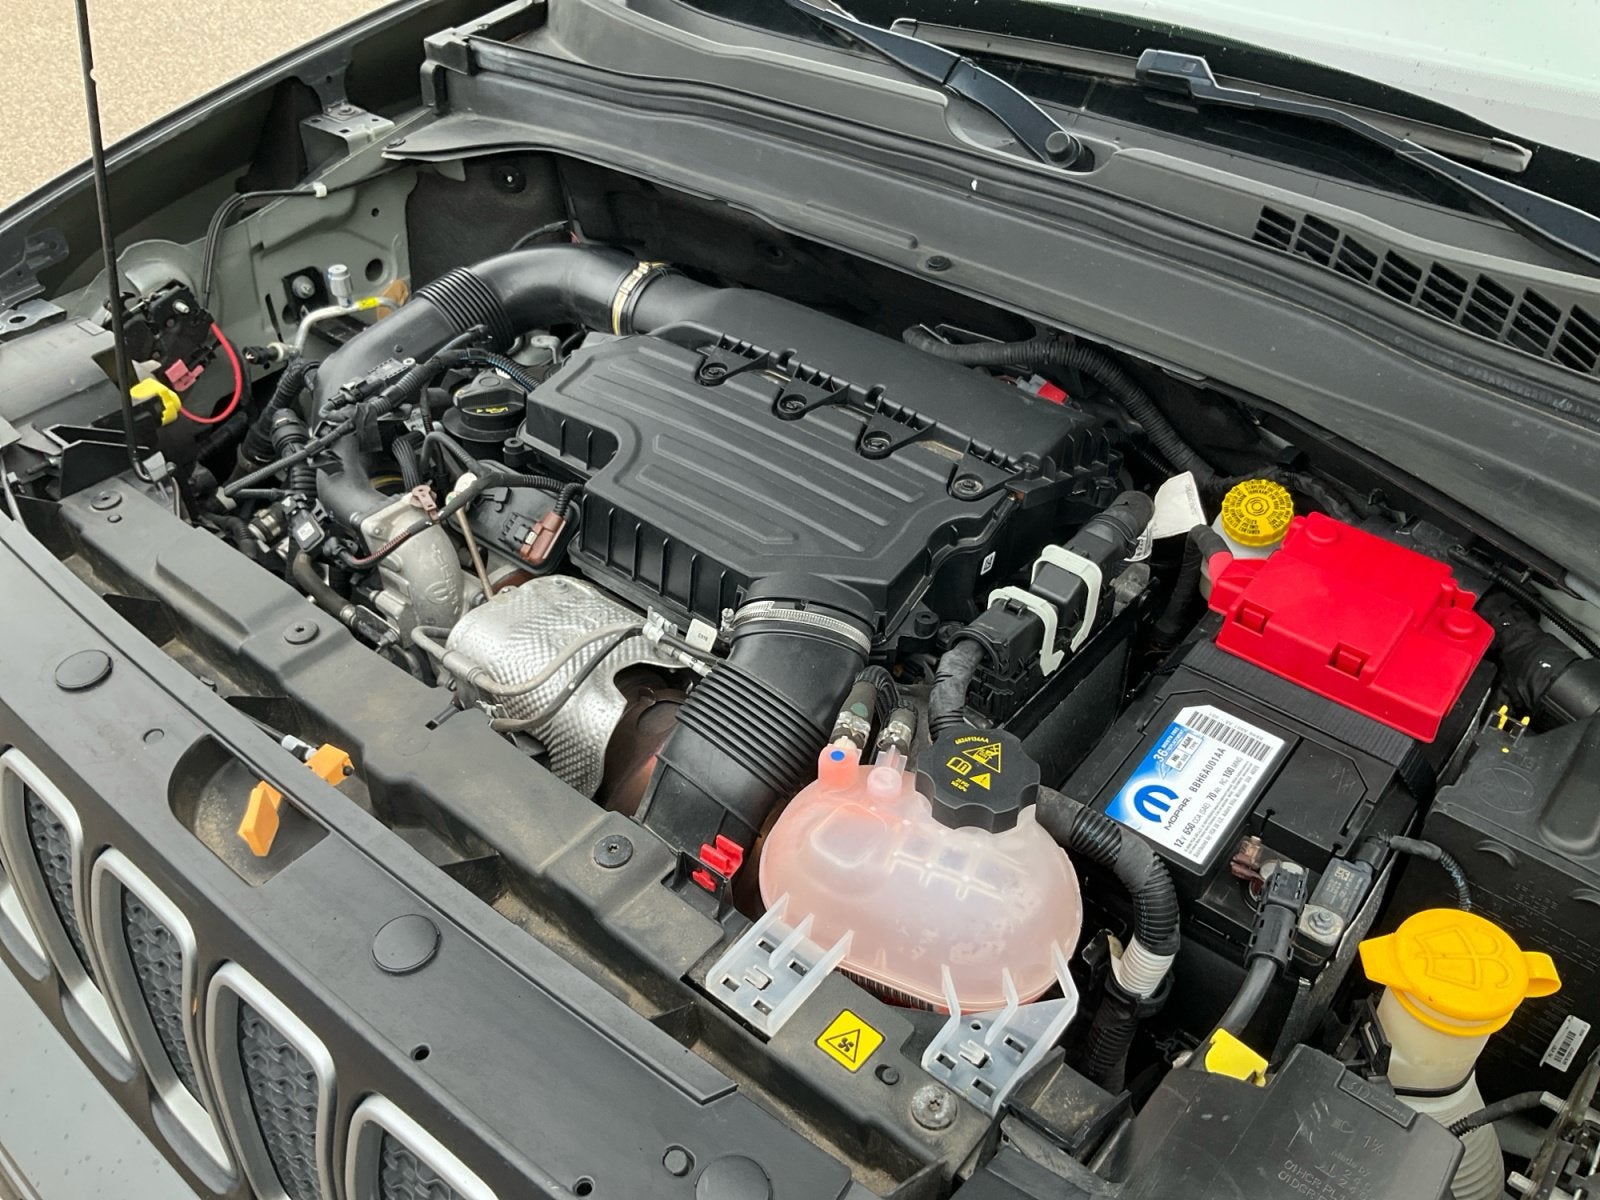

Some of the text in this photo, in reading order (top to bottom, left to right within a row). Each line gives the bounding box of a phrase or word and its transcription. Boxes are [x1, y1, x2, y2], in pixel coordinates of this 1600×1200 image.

[1152, 748, 1169, 762] 36
[1188, 746, 1226, 792] BBH6A001AA
[1164, 798, 1190, 831] MOPAR
[1173, 838, 1184, 848] 12
[1181, 821, 1196, 835] 650
[1206, 791, 1217, 801] 70
[1221, 766, 1235, 778] 100
